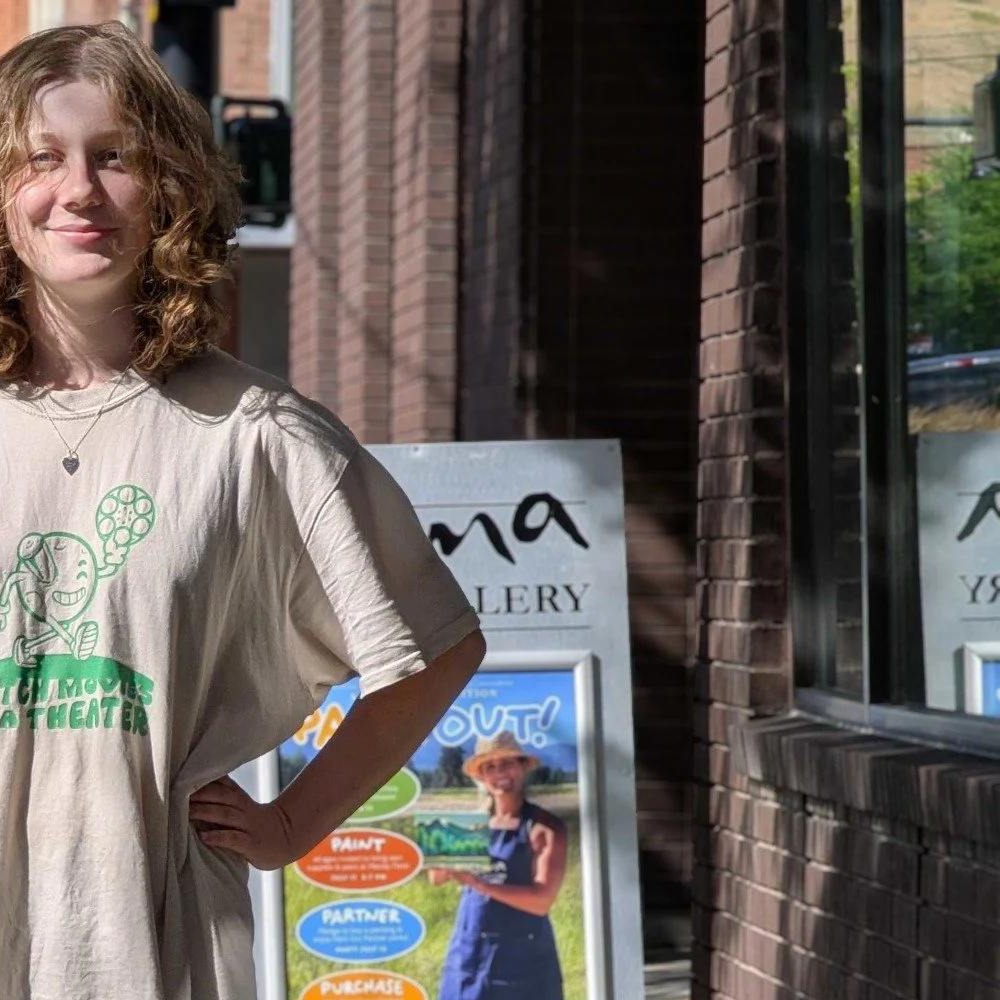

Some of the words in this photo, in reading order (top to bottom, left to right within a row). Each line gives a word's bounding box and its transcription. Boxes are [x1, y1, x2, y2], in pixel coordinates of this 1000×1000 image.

[475, 583, 590, 615] LERY
[0, 709, 20, 729] A
[26, 697, 148, 737] THEATER
[432, 695, 561, 749] OUT!
[330, 838, 386, 853] PAINT
[321, 907, 402, 926] PARTNER
[320, 978, 404, 996] PURCHASE
